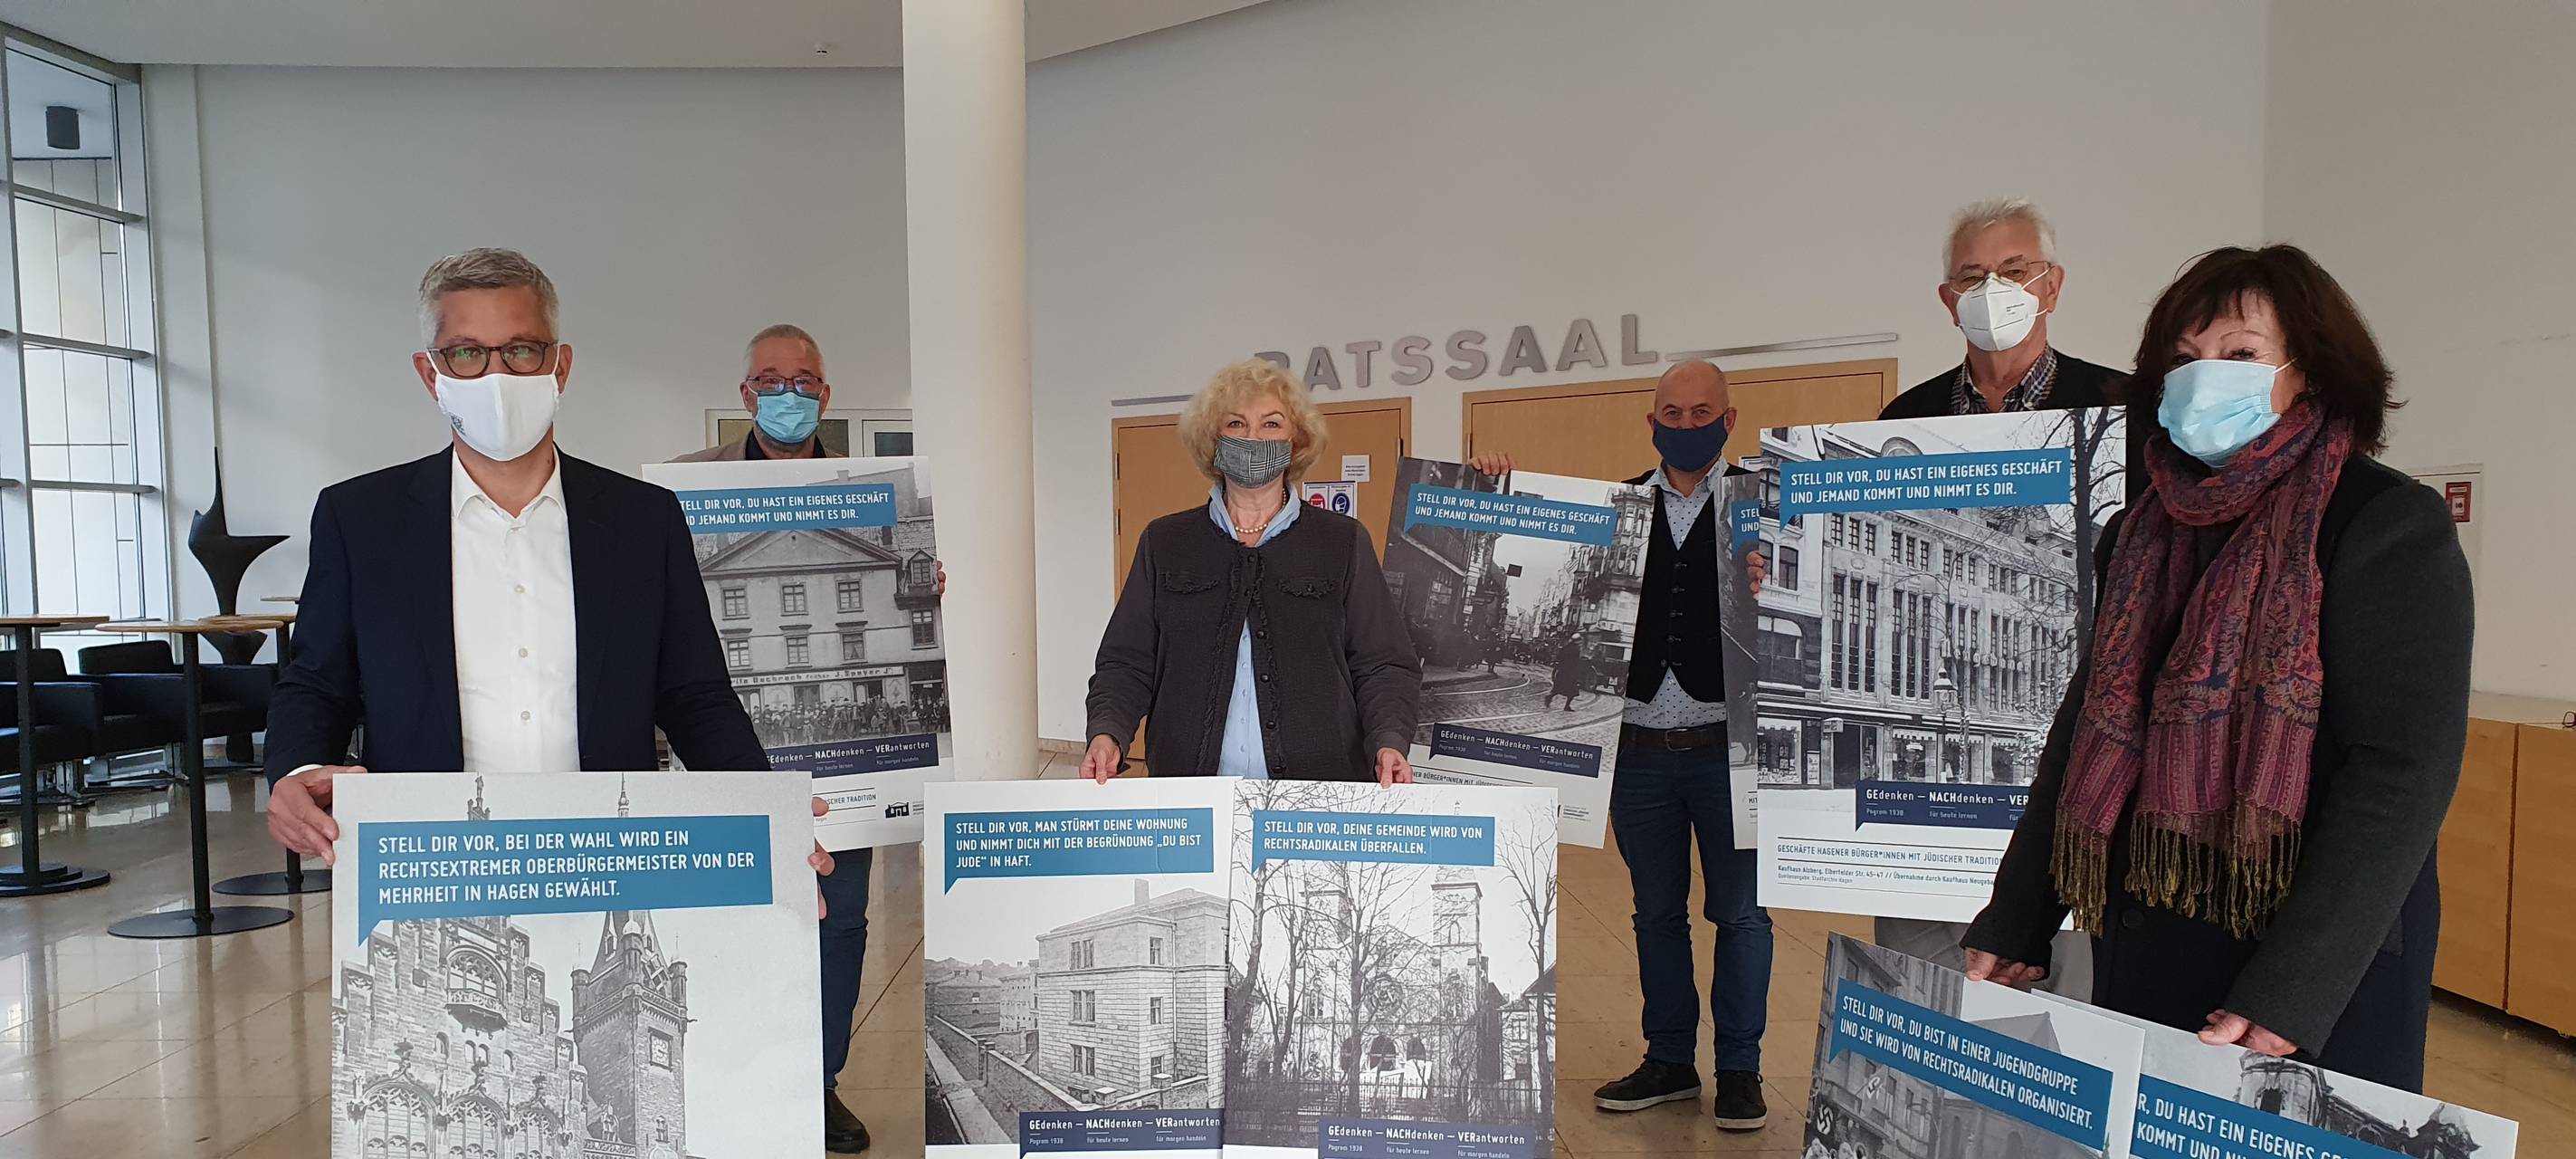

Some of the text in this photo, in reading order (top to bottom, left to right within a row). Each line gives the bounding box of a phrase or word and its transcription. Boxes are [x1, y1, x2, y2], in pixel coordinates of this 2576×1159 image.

[1791, 459, 2062, 485] STELL DIR VOR, DU HAST EIN EIGENES GESCHÄFT
[680, 491, 889, 511] TELL DIR VOR, DU HAST EIN EIGENES GESCHÄFT
[1791, 483, 2017, 503] UND JEMAND KOMMT UND NIMMT ES DIR.
[699, 514, 736, 525] JEMAND
[739, 512, 770, 523] KOMMT
[774, 512, 792, 522] UND
[796, 510, 825, 521] NIMMT
[827, 510, 838, 520] ES
[841, 509, 859, 520] DIR.
[1417, 493, 1610, 525] STELL DIR VOR, DU HAST EIN EIGENES GESCHÄFT
[1741, 508, 1760, 518] STEL
[1415, 506, 1578, 535] UND JEMAND KOMMT UND NIMMT ES DIR.
[1741, 522, 1759, 532] UND
[816, 748, 864, 760] NACHdenken
[875, 741, 930, 753] VERantworten
[1440, 730, 1594, 760] GEdenken NACHdenken VERantworten
[846, 794, 876, 803] TRADITION
[1866, 789, 1914, 800] GEdenken
[1929, 791, 1994, 804] NACHdenken
[956, 818, 1188, 834] STELL DIR VOR, MAN STÜRMT DEINE WOHNUNG
[1264, 822, 1482, 838] STELL DIR VOR, DEINE GEMEINDE WIRD VON
[378, 829, 689, 854] STELL DIR VOR, BEI DER WAHL WIRD EIN
[956, 839, 977, 850] UND
[981, 838, 1013, 850] NIMMT
[1017, 838, 1040, 849] DICH
[1044, 837, 1061, 848] MIT
[1064, 837, 1083, 848] DER
[1086, 833, 1153, 848] BEGRÜNDUNG
[1179, 835, 1201, 846] BIST
[1264, 838, 1426, 855] RECHTSRADIKALEN ÜBERFALLEN.
[990, 856, 1001, 867] IN
[1005, 855, 1032, 867] HAFT.
[1777, 844, 1815, 854] GESCHÄFTE
[1818, 848, 1849, 857] HAGENER
[1908, 853, 1921, 861] MIT
[1923, 852, 1962, 863] JÜDISCHER
[1965, 856, 2002, 866] TRADITIO
[378, 852, 754, 879] RECHTSEXTREMER OBERBÜRGERMEISTER VON DER
[378, 879, 620, 905] MEHRHEIT IN HAGEN GEWÄHLT.
[1843, 996, 2078, 1096] STELL DIR VOR, DU BIST IN EINER JUGENDGRUPPE
[1840, 1019, 2093, 1130] UND SIE WIRD VON RECHTSRADIKALEN ORGANISIERT.
[1029, 1117, 1220, 1130] GEdenken NACHdenken VERantworten
[2155, 1098, 2173, 1120] DU
[2178, 1106, 2216, 1133] HAST
[2219, 1119, 2245, 1144] EIN
[2248, 1129, 2314, 1159] EIGENES
[1328, 1125, 1524, 1145] GEdenken NACHdenken VERantworten
[2137, 1122, 2219, 1159] KOMMT UND
